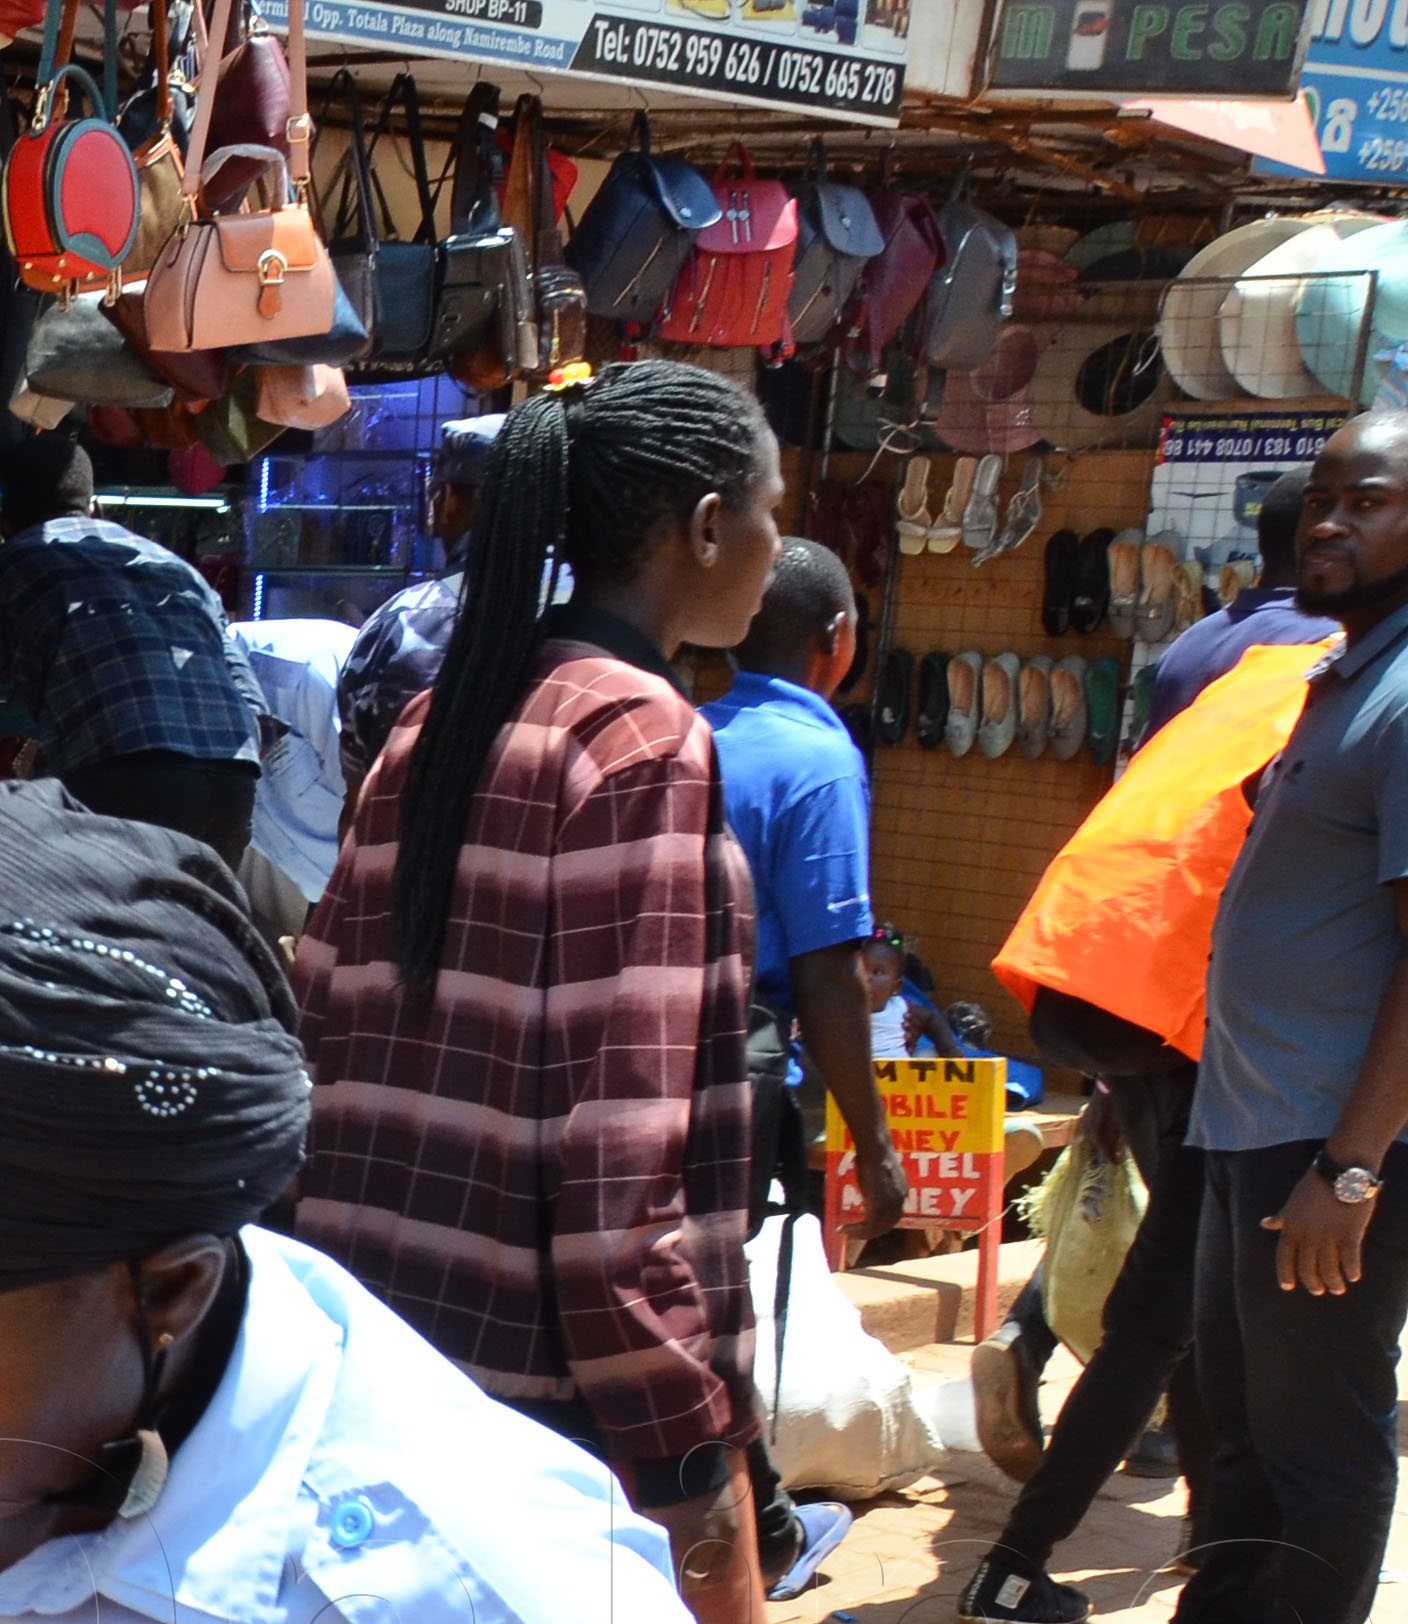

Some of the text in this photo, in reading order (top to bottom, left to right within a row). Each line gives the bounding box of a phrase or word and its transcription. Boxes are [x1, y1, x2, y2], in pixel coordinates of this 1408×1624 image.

[488, 0, 528, 23] BP-11
[312, 3, 344, 29] Opp.
[348, 8, 388, 31] Totala
[391, 15, 424, 37] Plaza
[427, 22, 463, 49] along
[463, 26, 532, 55] Namirembe
[534, 39, 566, 60] Road
[1126, 4, 1300, 61] PESA
[594, 20, 629, 63] Tel:
[633, 26, 682, 71] 0752
[685, 37, 723, 77] 959
[725, 42, 761, 86] 626
[778, 51, 824, 94] 0752
[825, 59, 860, 101] 665
[861, 66, 897, 105] 278
[1263, 437, 1291, 456] 183
[838, 1152, 981, 1179] ATEL
[841, 1184, 977, 1217] MNEY
